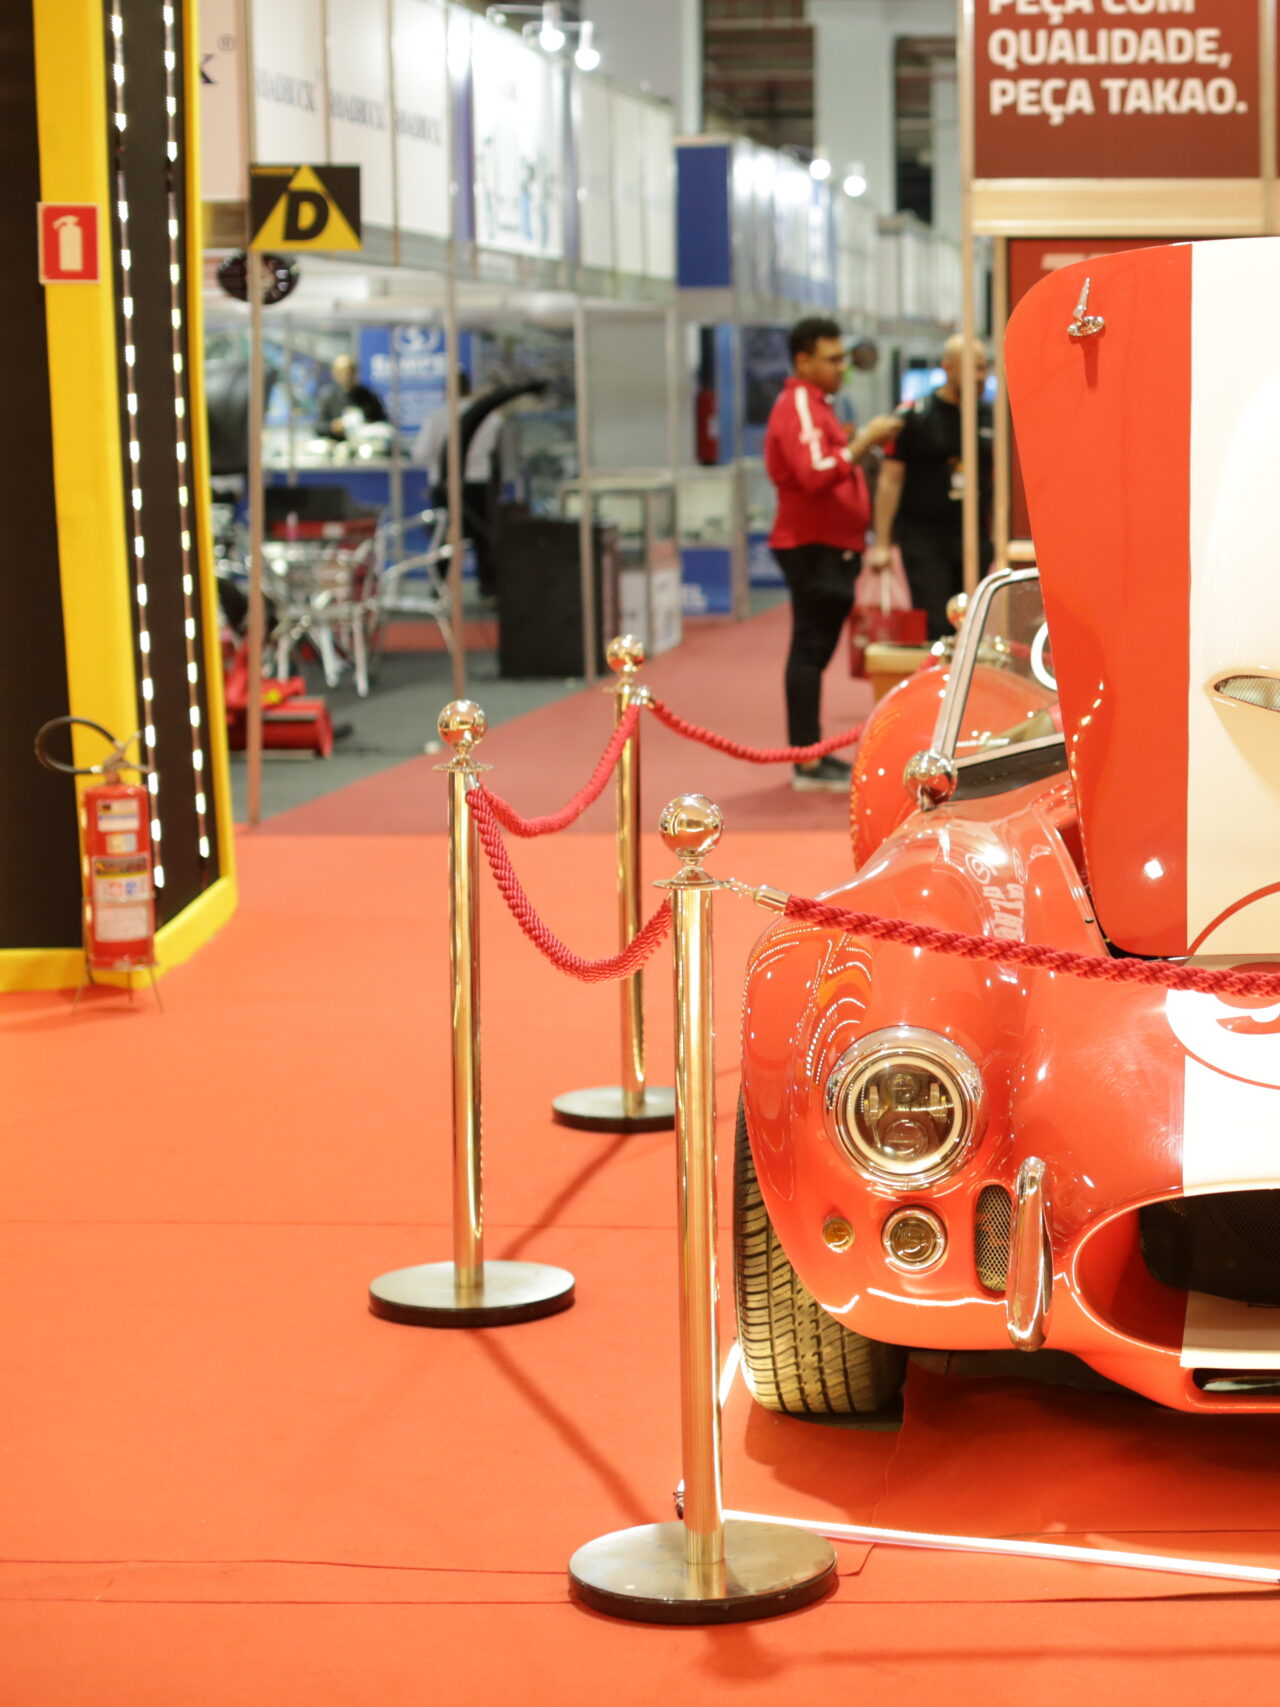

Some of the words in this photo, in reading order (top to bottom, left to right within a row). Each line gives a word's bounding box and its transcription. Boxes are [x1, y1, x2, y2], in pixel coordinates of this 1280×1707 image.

[987, 27, 1232, 71] QUALIDADE,
[988, 78, 1096, 127] PEÇA
[1099, 77, 1249, 115] TAKAO.
[283, 191, 330, 241] D
